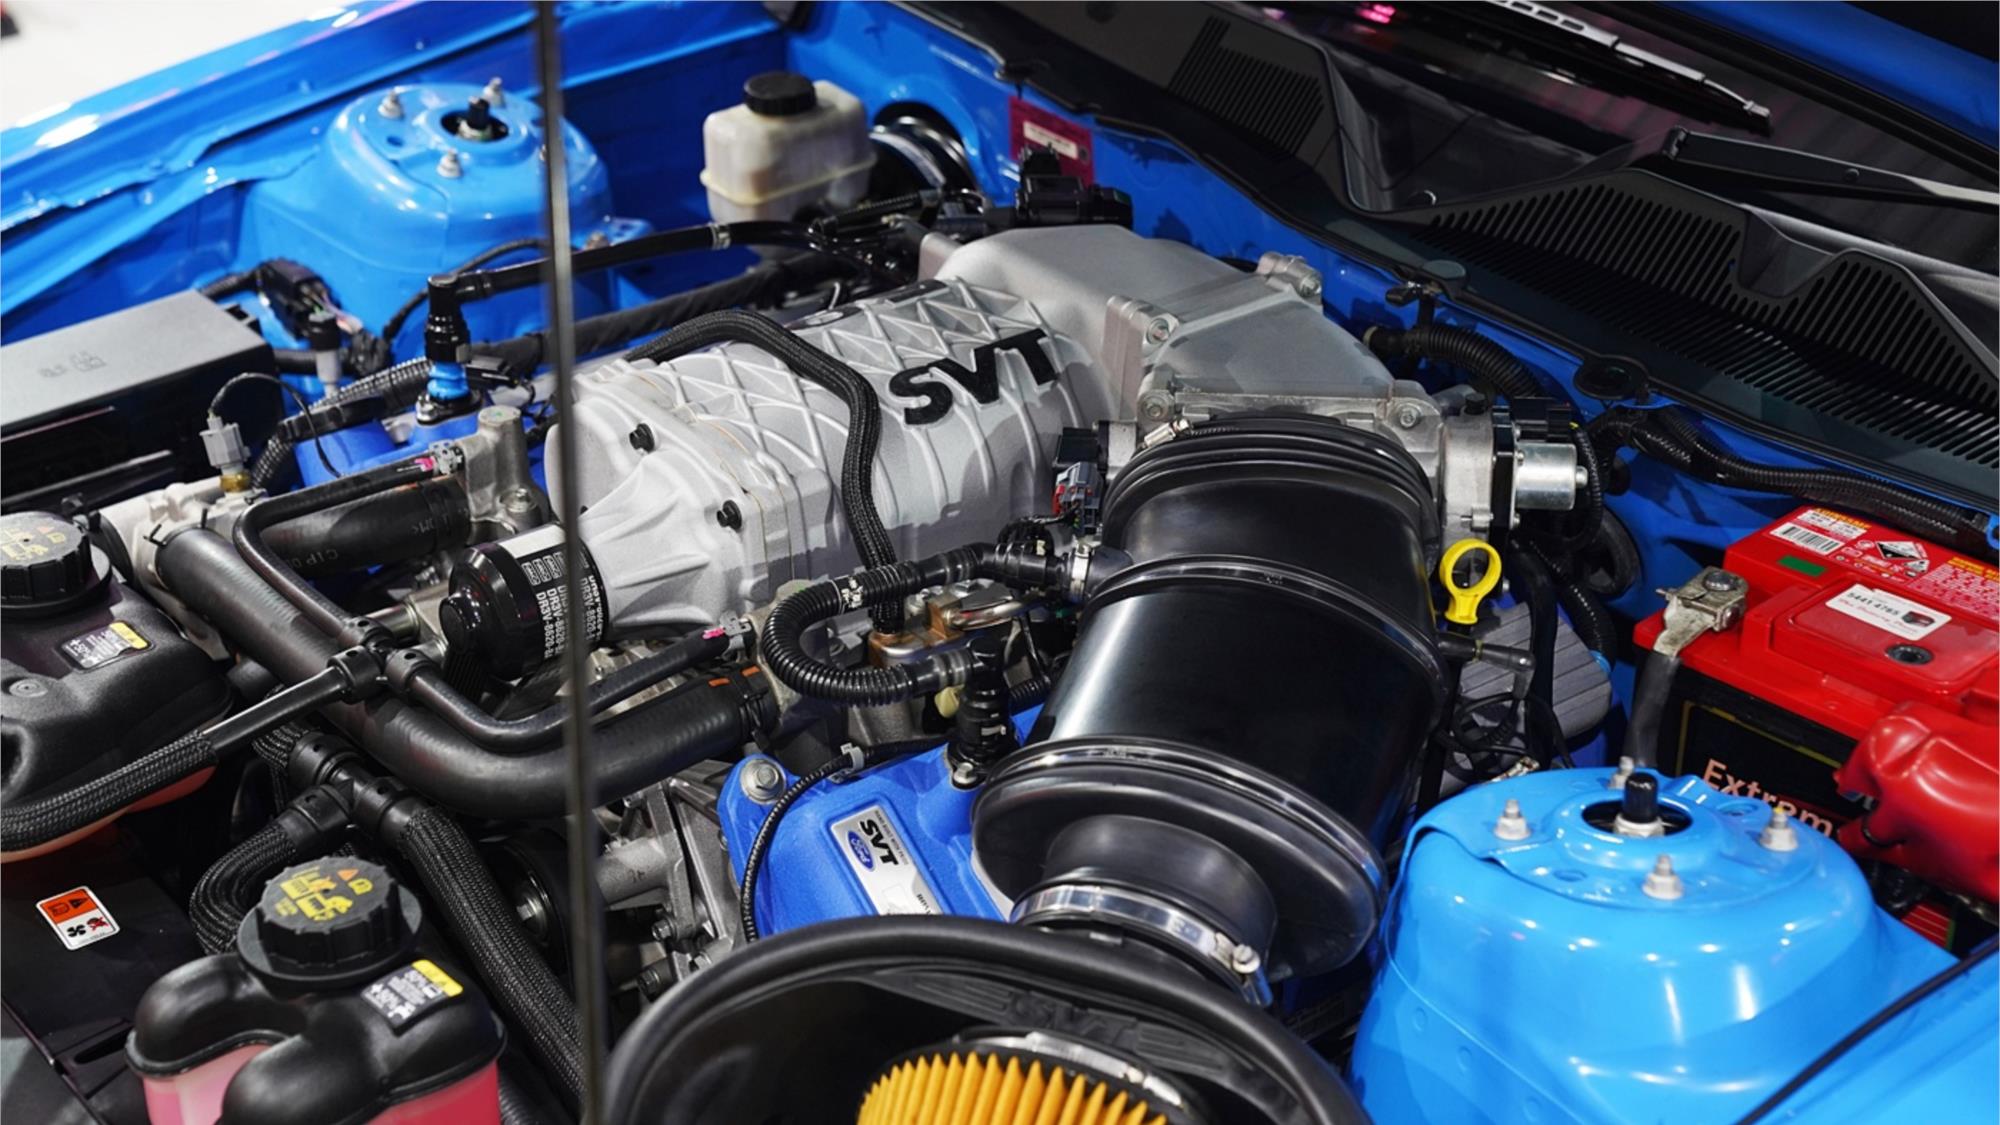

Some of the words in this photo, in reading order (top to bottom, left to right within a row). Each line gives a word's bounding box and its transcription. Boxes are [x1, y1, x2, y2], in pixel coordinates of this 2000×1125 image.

[889, 328, 1059, 425] SVT
[1703, 758, 1833, 837] Extrem
[849, 835, 872, 866] Ford
[860, 819, 899, 866] SVT
